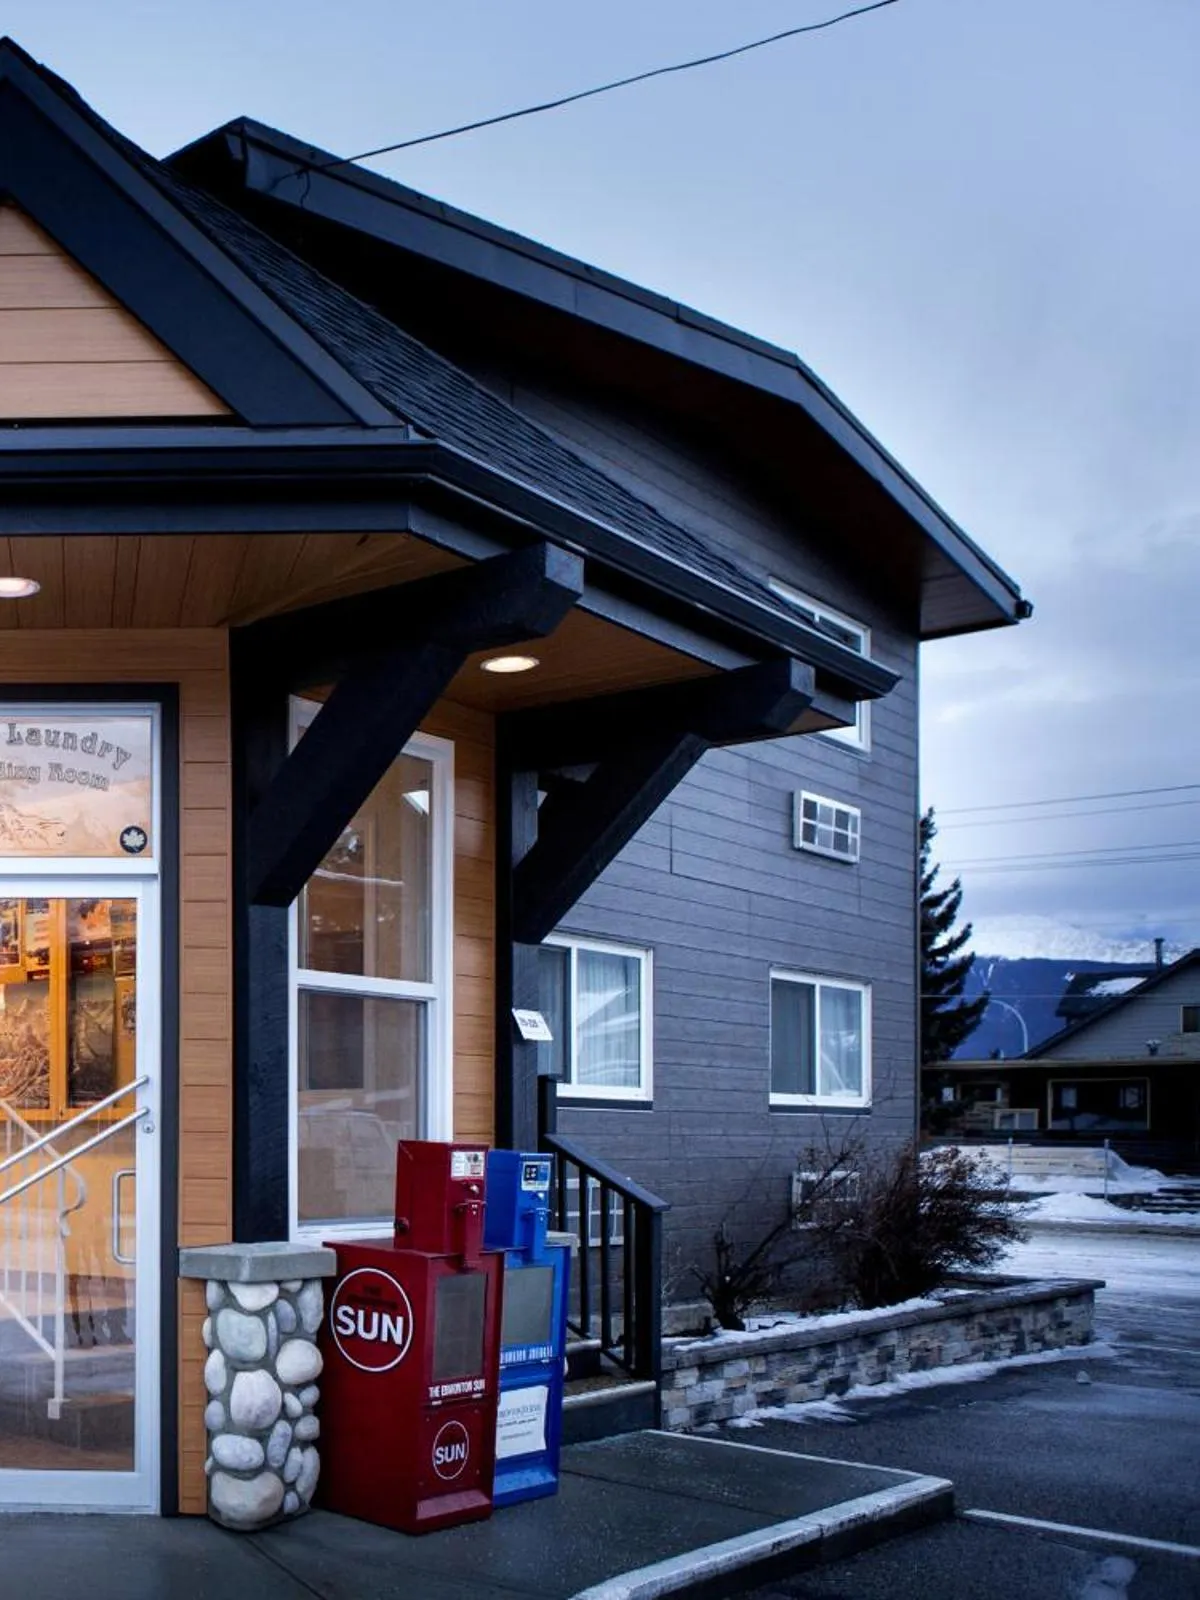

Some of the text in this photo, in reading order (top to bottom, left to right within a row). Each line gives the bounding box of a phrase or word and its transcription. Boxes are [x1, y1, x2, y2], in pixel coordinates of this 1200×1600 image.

[6, 722, 132, 770] Laundry
[47, 762, 110, 791] Room
[335, 1304, 404, 1346] SUN
[435, 1442, 465, 1465] SUN
